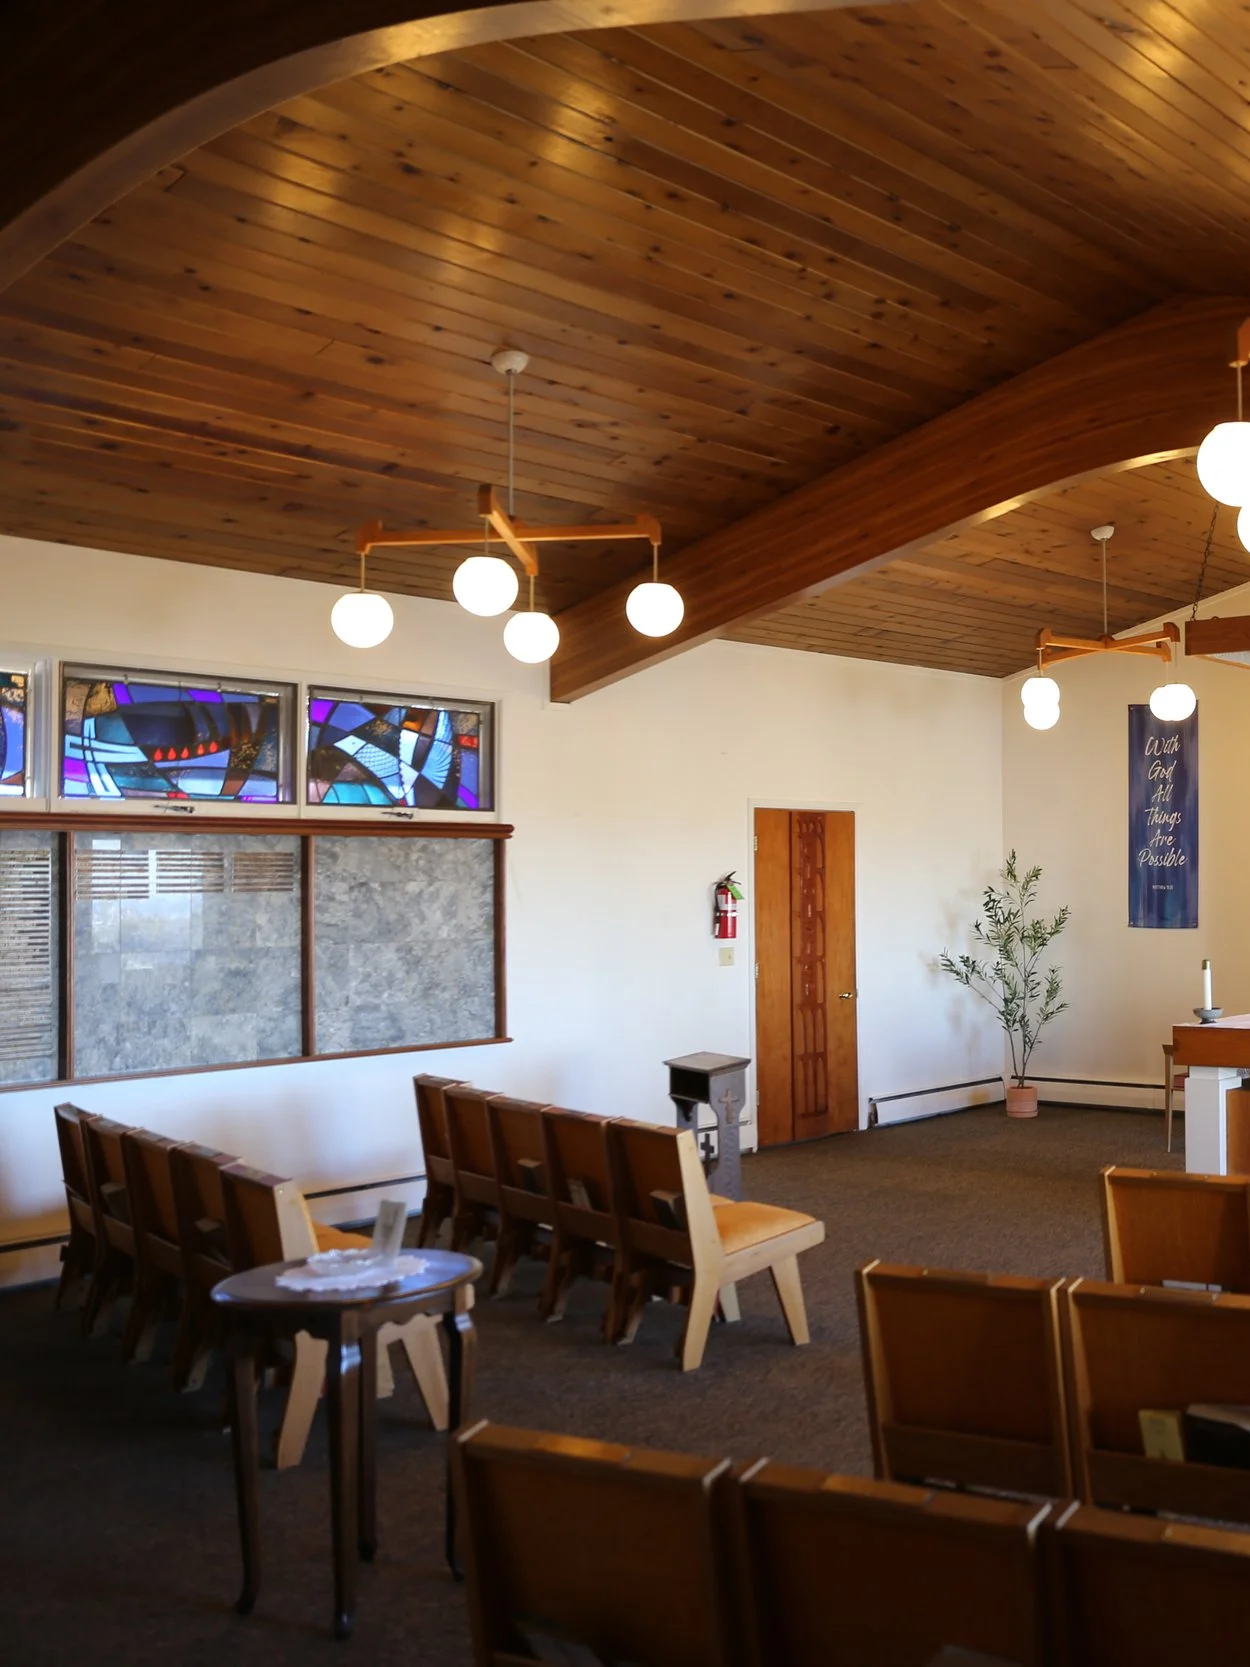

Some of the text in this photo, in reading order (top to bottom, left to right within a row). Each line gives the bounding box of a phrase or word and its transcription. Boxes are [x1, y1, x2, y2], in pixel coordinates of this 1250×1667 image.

[1145, 734, 1181, 756] With
[1148, 760, 1177, 782] God
[1151, 784, 1174, 803] All
[1145, 806, 1182, 832] Things
[1149, 829, 1176, 847] Are
[1138, 847, 1189, 867] Possible
